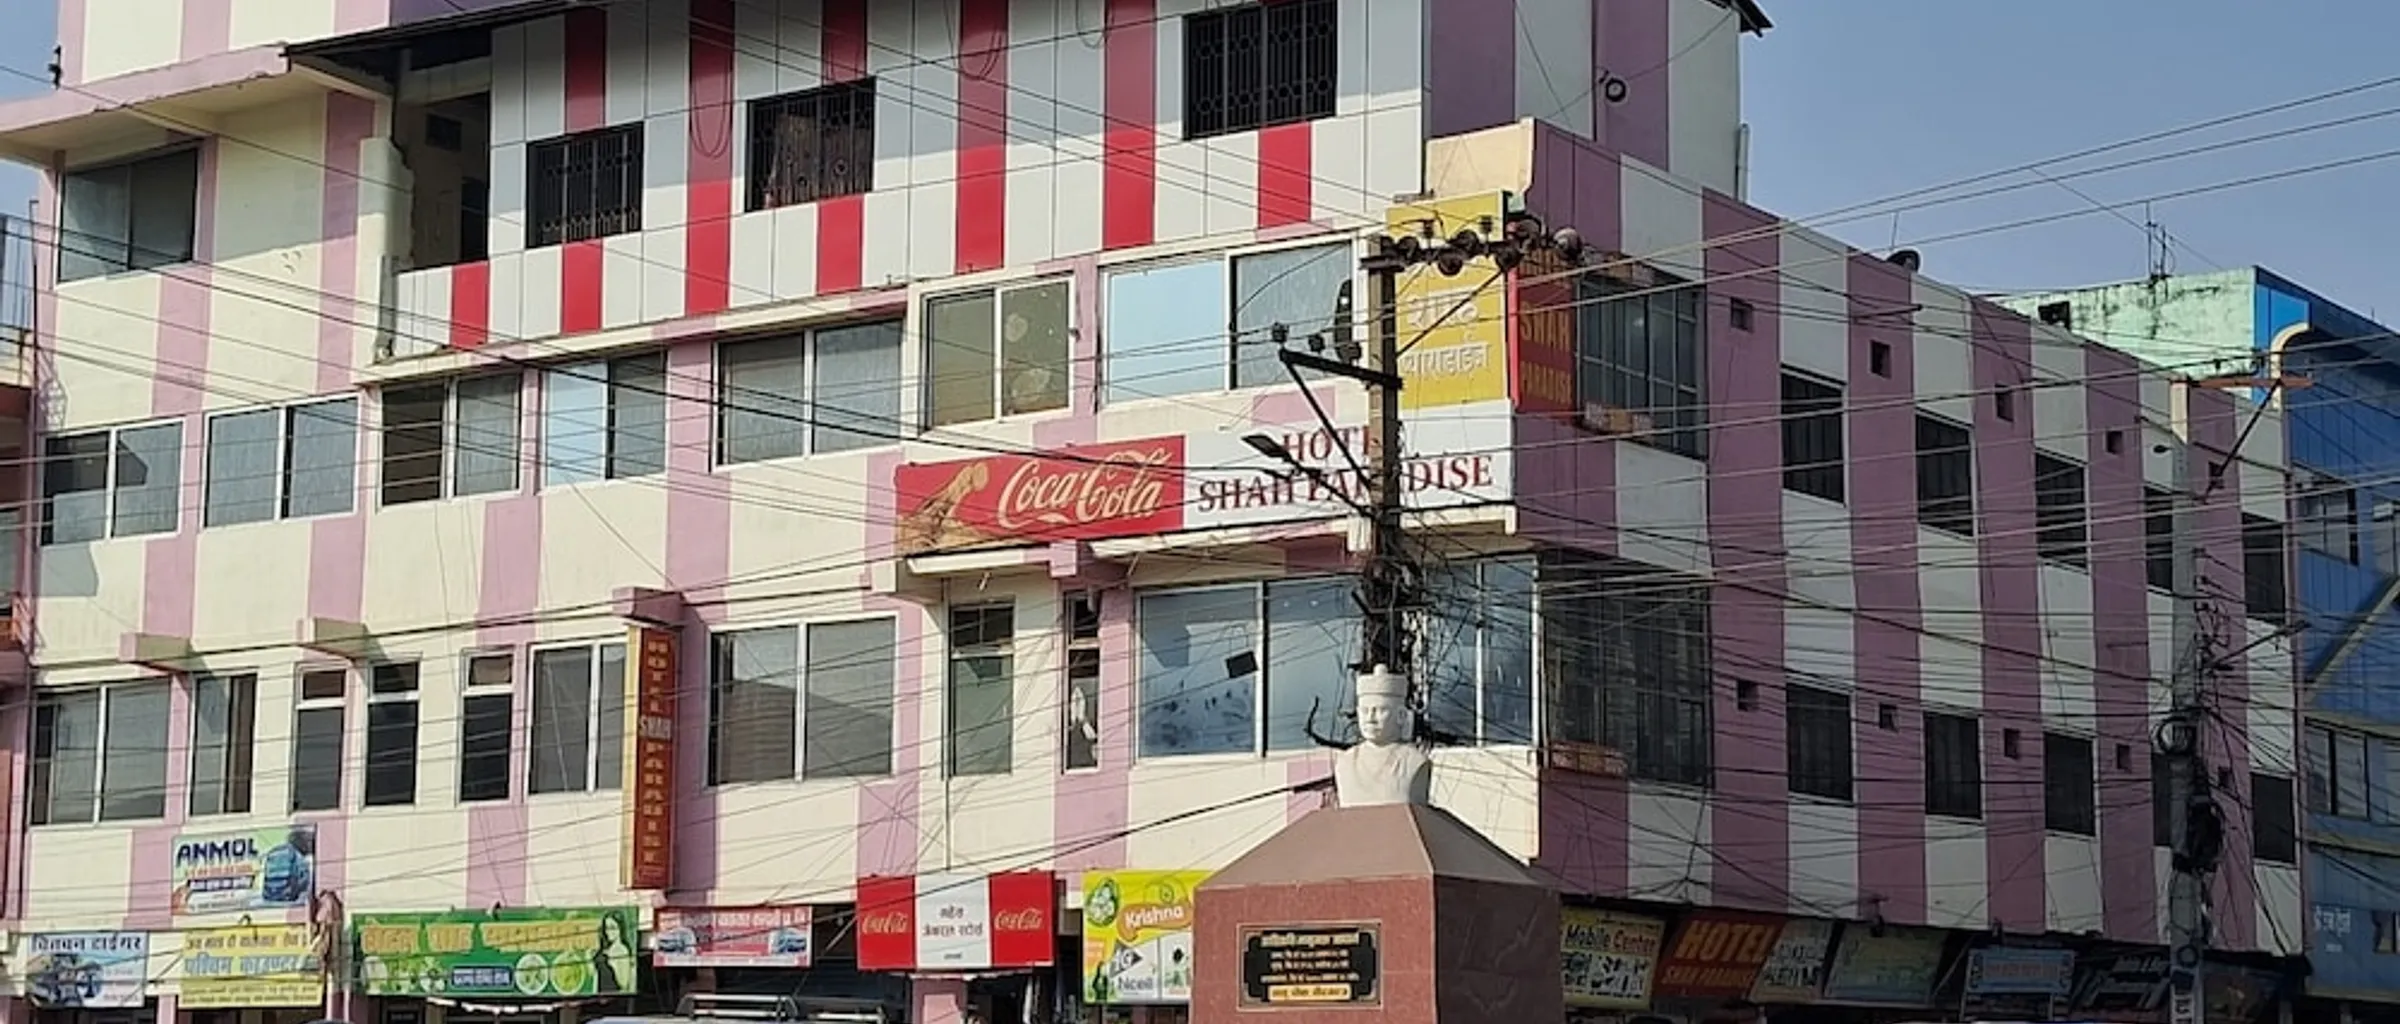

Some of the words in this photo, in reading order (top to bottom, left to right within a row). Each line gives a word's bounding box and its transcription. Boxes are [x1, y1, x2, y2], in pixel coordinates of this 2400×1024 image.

[1520, 302, 1570, 354] SHAH
[1520, 361, 1573, 406] PARADISE
[1309, 455, 1493, 502] PADISE
[638, 714, 672, 740] SHAH
[176, 838, 259, 867] ANMOL
[1125, 905, 1185, 929] Krishna
[1565, 924, 1611, 949] Mobile
[1613, 930, 1656, 954] Center
[1673, 920, 1776, 962] HOTEL
